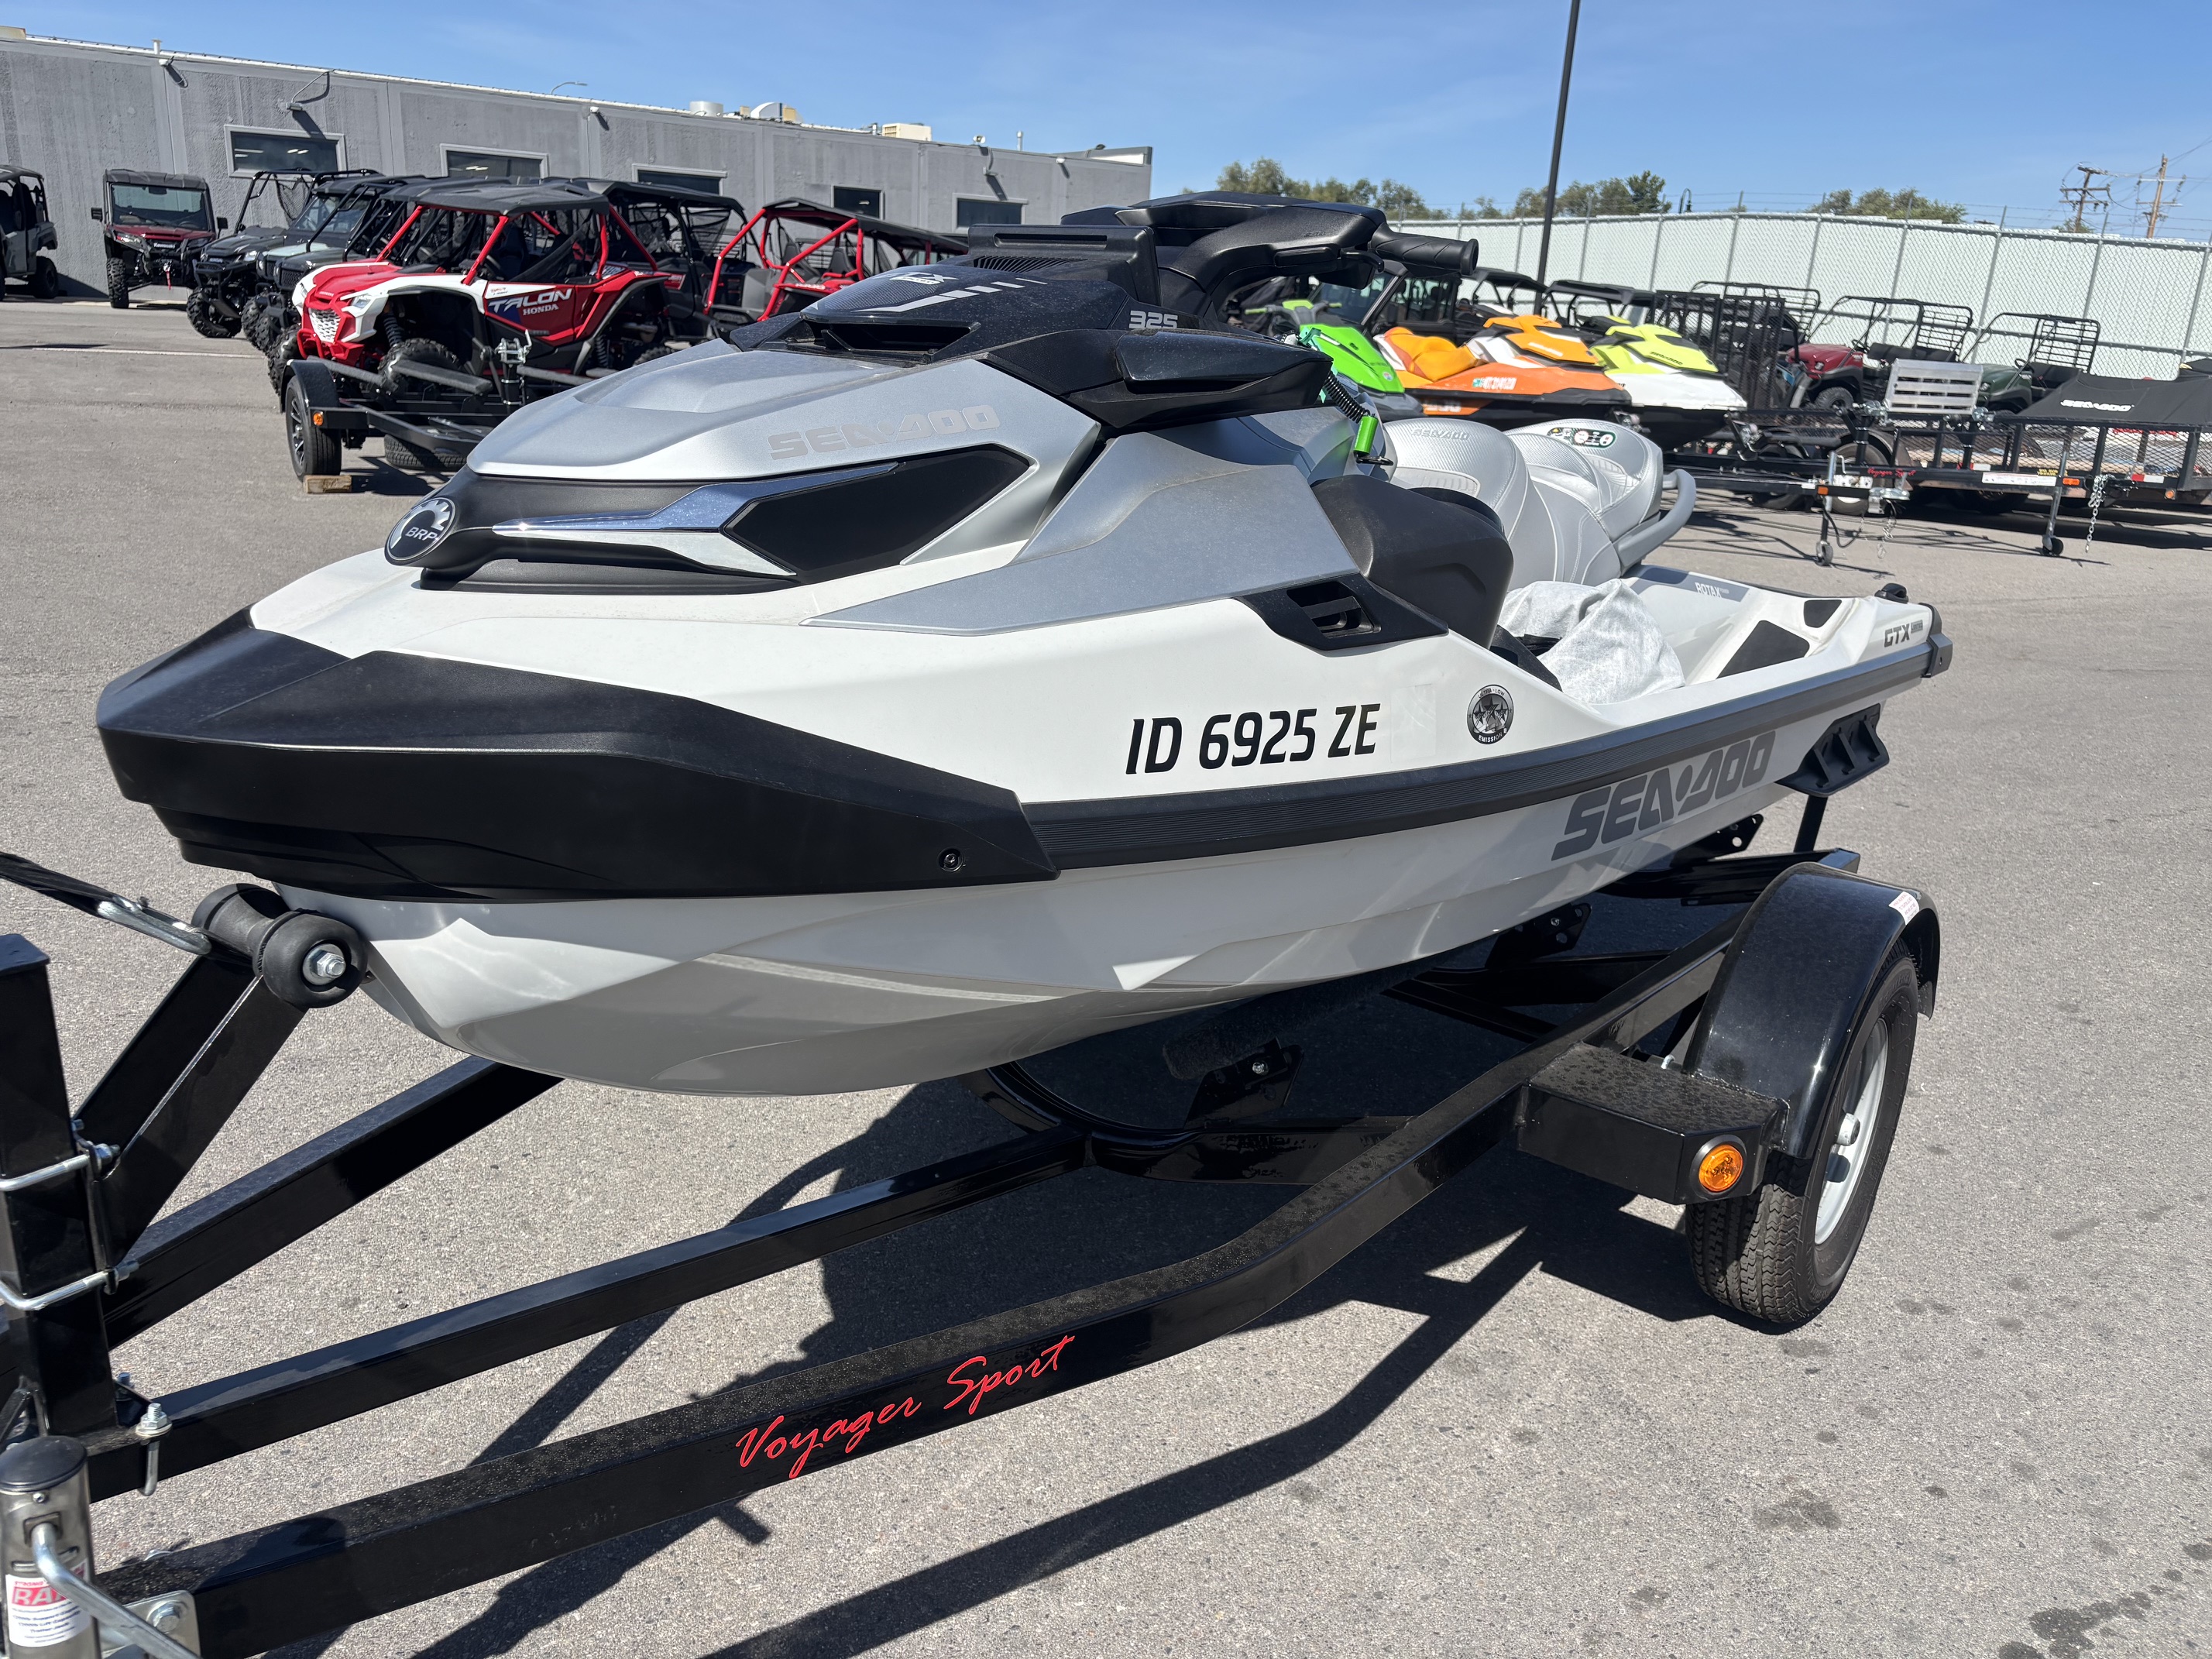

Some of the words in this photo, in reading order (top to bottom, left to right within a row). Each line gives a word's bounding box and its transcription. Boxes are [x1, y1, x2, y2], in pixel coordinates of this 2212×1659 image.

[488, 288, 573, 314] TALON
[522, 303, 559, 316] HONDA
[1128, 310, 1178, 329] 325
[405, 527, 438, 541] BRP
[1695, 582, 1723, 598] ROTAX
[1884, 623, 1910, 647] GTX
[1126, 716, 1182, 775] ID
[1199, 708, 1317, 770] 6925
[1328, 703, 1381, 758] ZE
[1478, 732, 1503, 743] EMISSION
[735, 1396, 922, 1479] Voyager
[943, 1335, 1075, 1415] Sport
